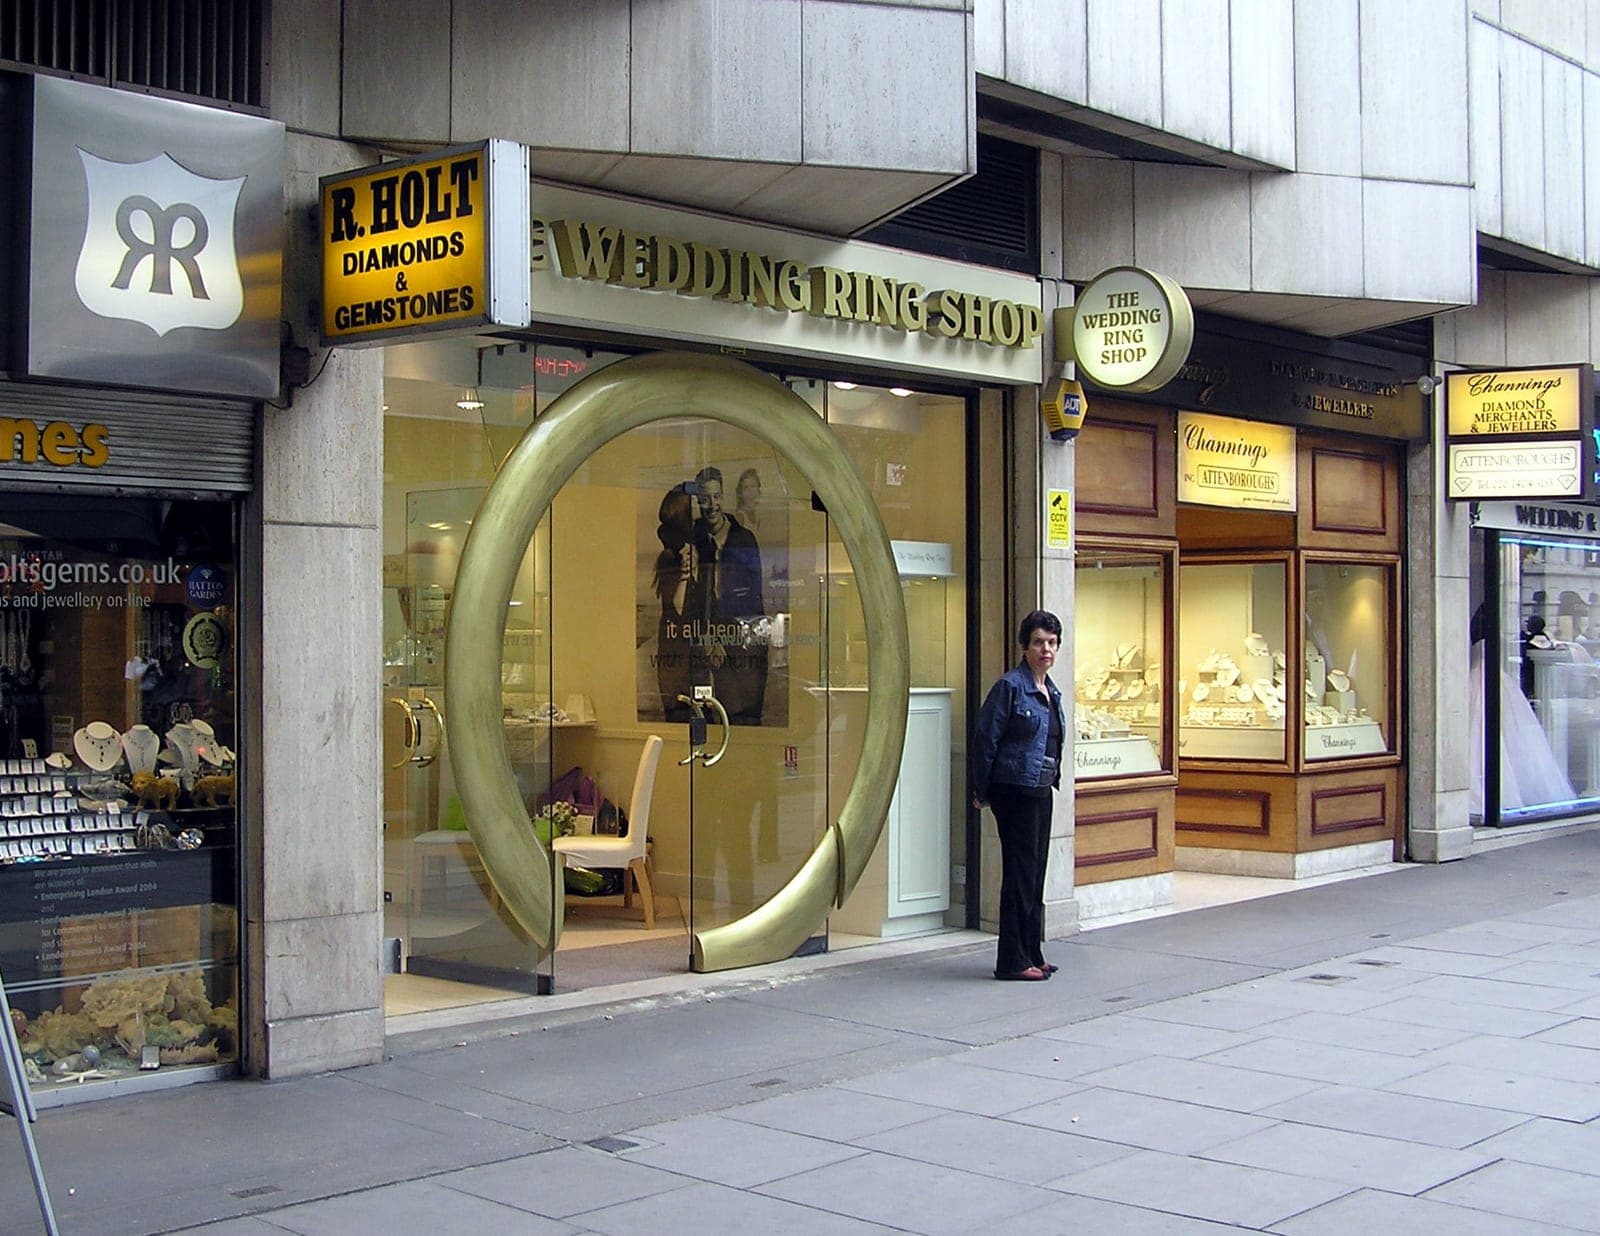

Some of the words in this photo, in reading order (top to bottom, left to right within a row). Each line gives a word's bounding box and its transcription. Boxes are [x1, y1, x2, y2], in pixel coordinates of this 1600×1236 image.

[343, 231, 465, 277] DIAMONDS
[395, 271, 409, 293] &
[556, 219, 811, 313] WEDDING
[818, 265, 928, 332] RING
[934, 289, 1045, 349] SHOP
[334, 285, 476, 331] GEMSTONES
[1106, 291, 1140, 309] THE
[1082, 308, 1162, 329] WEDDING
[1103, 329, 1144, 346] RING
[1101, 347, 1148, 364] SHOP
[1467, 374, 1562, 401] Channings
[1064, 398, 1080, 411] ADT
[1307, 394, 1377, 419] JEWELLERS
[1482, 399, 1546, 412] DIAMOND
[1474, 409, 1553, 423] MERCHANTS
[1470, 424, 1480, 434] &
[1487, 419, 1557, 433] JEWELLERS
[0, 416, 110, 468] nes
[1184, 423, 1269, 468] Channings
[1459, 452, 1571, 467] ATTENBOROUGHS
[1202, 469, 1276, 490] ATTENBOROUGHS
[1050, 512, 1067, 523] CCTV
[0, 554, 182, 590] oltsgems.co.uk
[13, 592, 38, 608] and
[41, 591, 103, 611] jewellery
[107, 592, 152, 608] on-line
[666, 619, 677, 639] it
[683, 619, 700, 638] all
[1075, 751, 1122, 770] Channings
